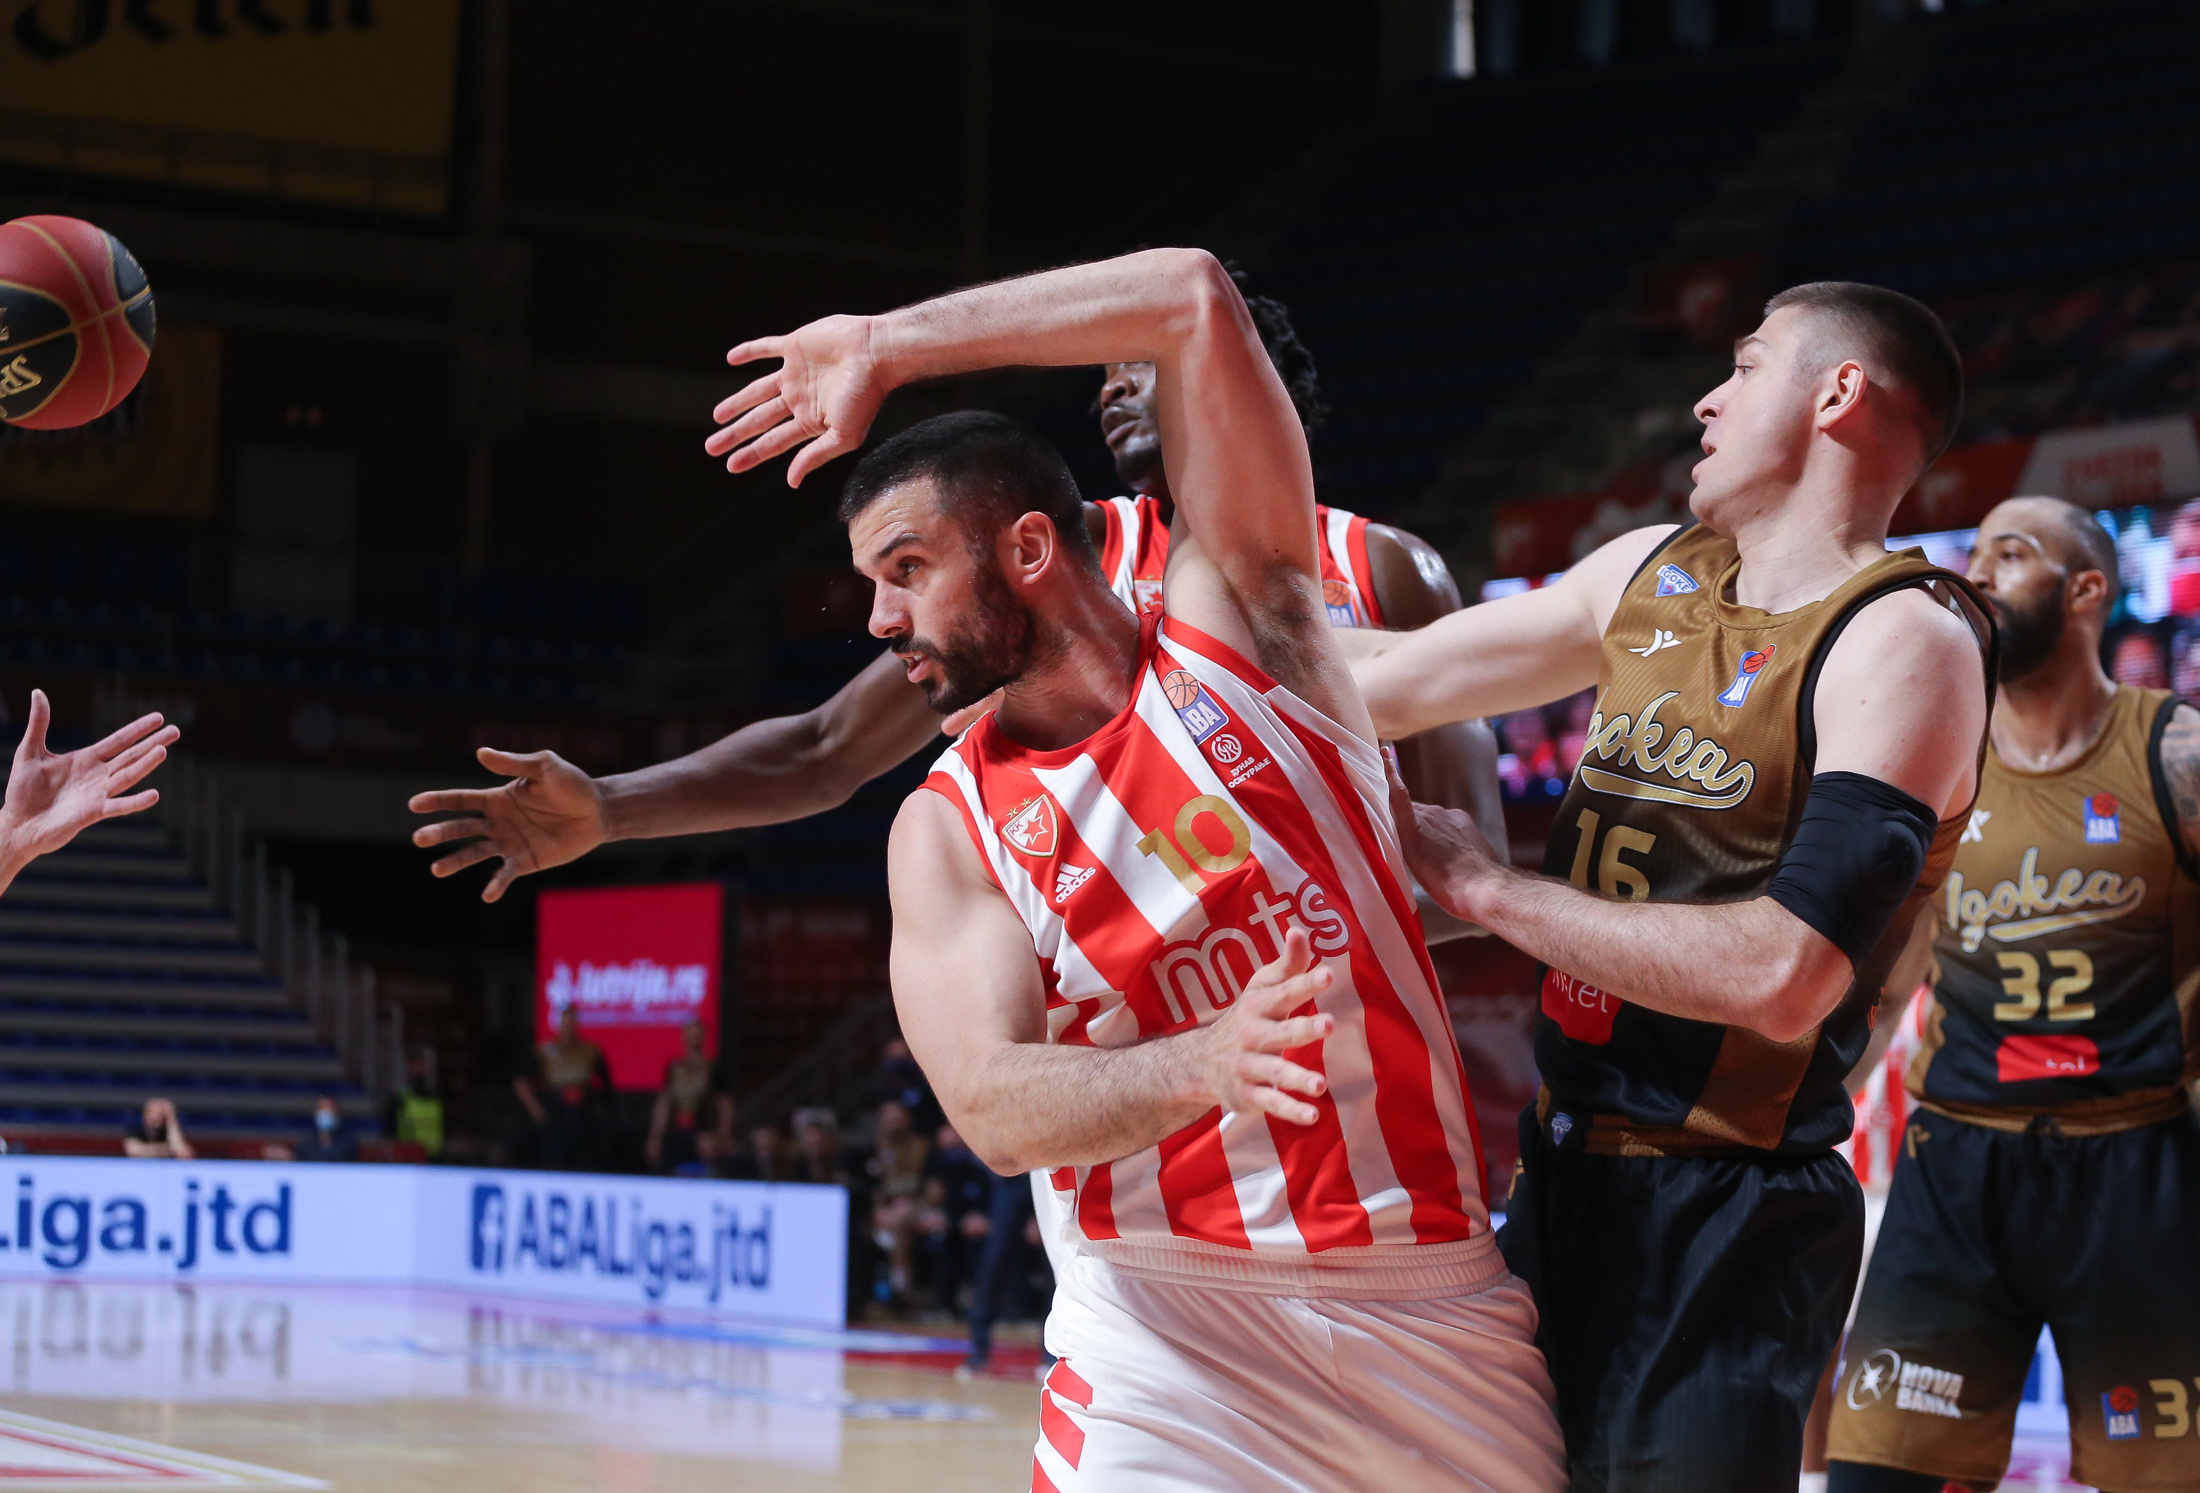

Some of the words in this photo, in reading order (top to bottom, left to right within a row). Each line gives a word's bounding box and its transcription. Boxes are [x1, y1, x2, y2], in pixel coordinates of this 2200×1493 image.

[1659, 567, 1691, 592] IGOKE
[1055, 866, 1097, 904] adidas
[1136, 794, 1252, 896] 10
[1570, 807, 1658, 902] 16
[1150, 883, 1349, 1025] mts
[1993, 950, 2096, 1021] 32
[0, 1175, 292, 1269] iga.jtd
[515, 1193, 771, 1304] ABALiga.jtd
[2149, 1376, 2200, 1437] 3
